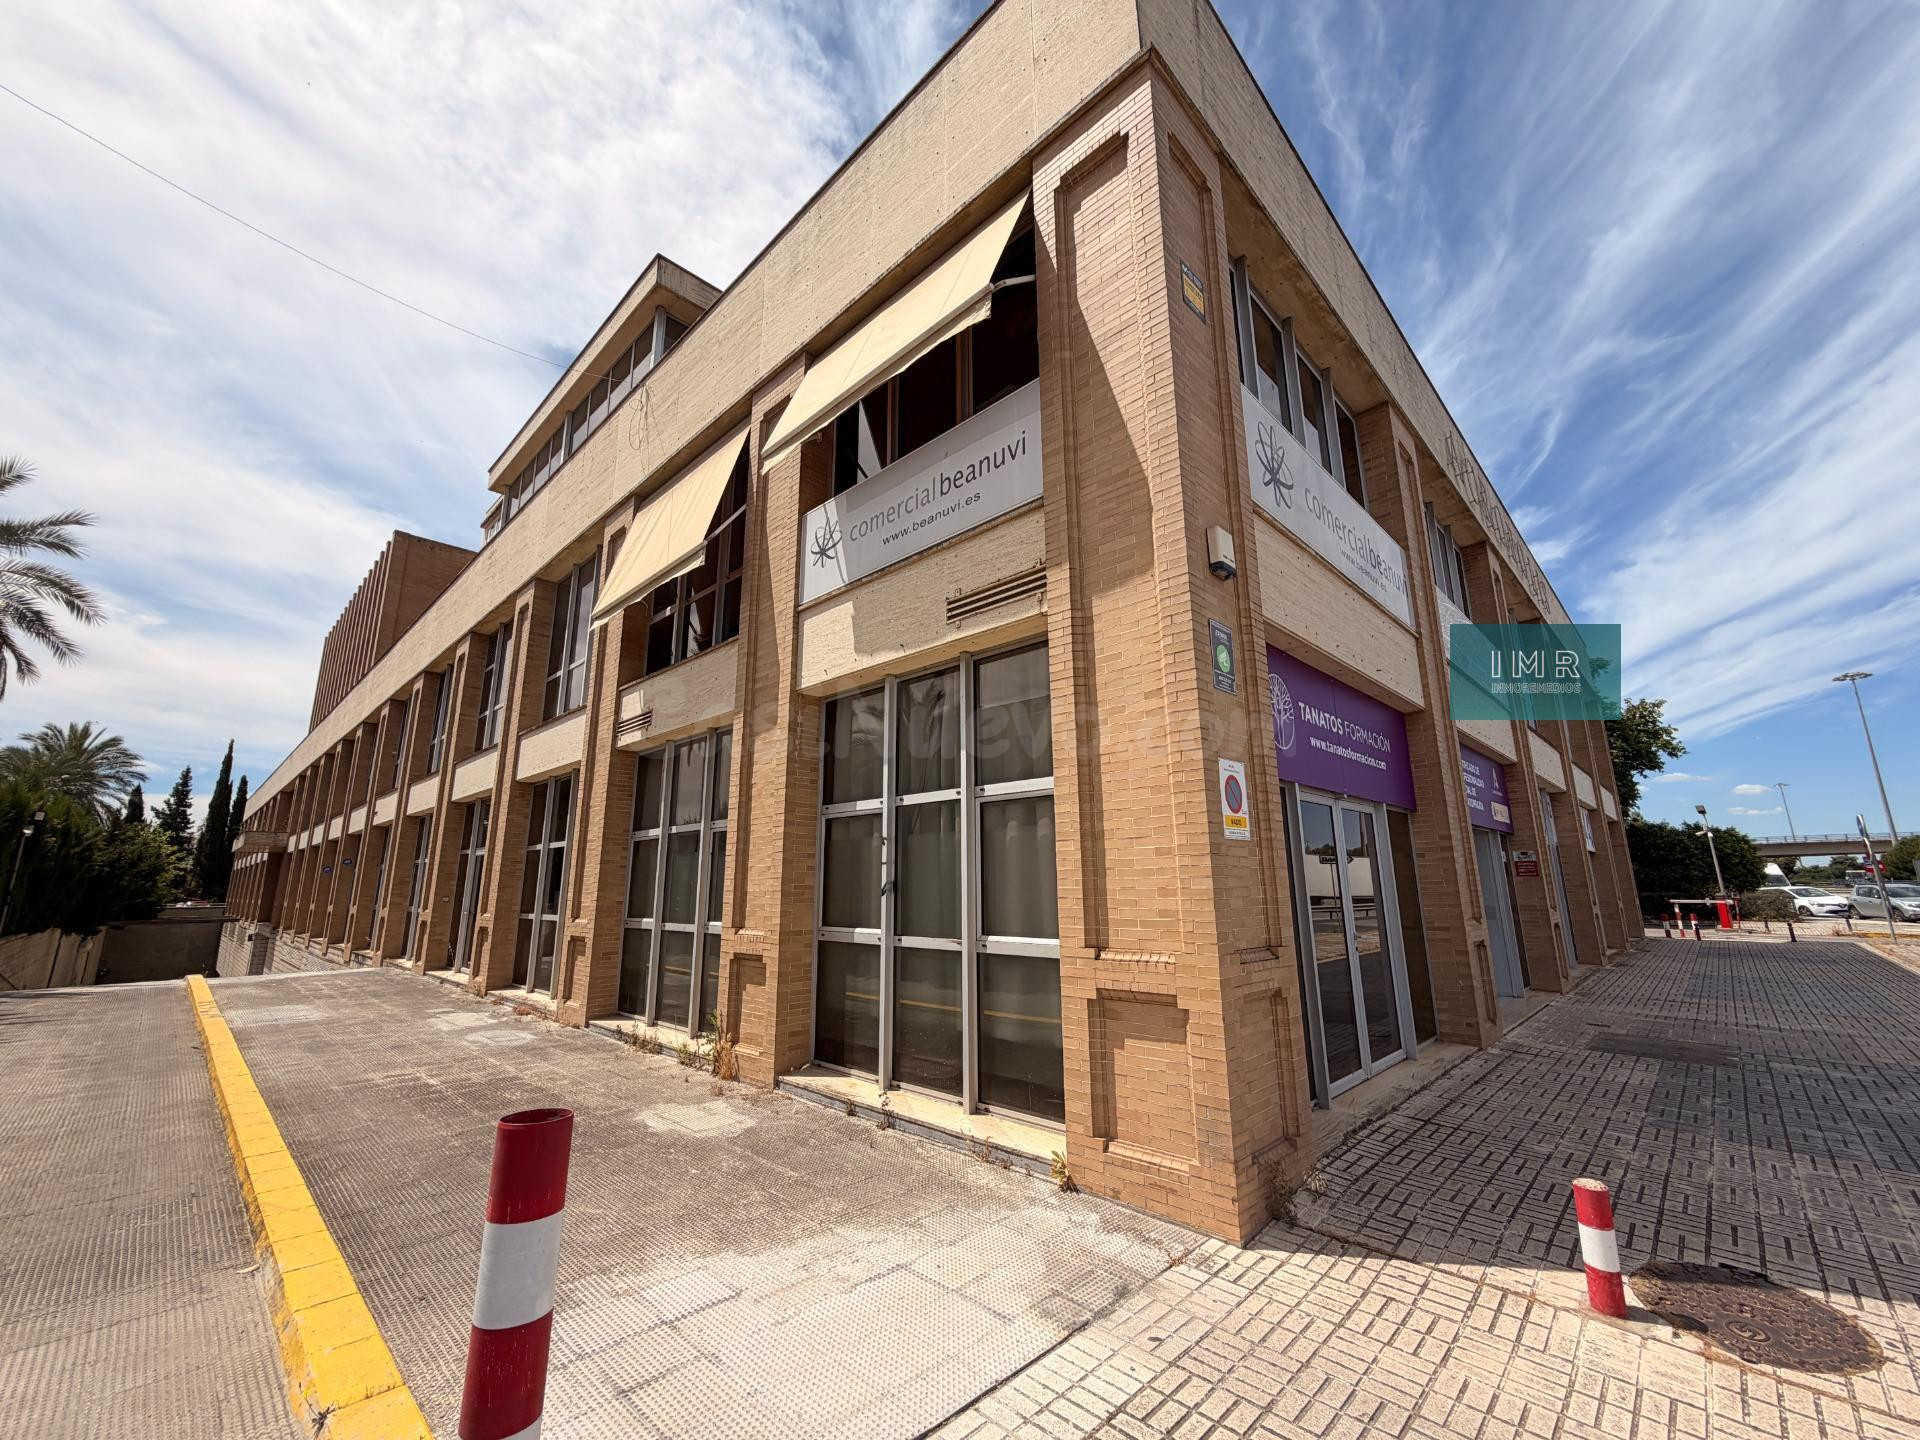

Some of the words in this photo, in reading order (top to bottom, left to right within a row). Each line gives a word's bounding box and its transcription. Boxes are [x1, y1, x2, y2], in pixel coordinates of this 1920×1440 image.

[882, 491, 981, 546] www.beanuvi.es
[1298, 701, 1343, 736] TANATOS
[1344, 720, 1391, 753] FORMACIÓN
[1310, 736, 1387, 771] www.tanatosformacion.com
